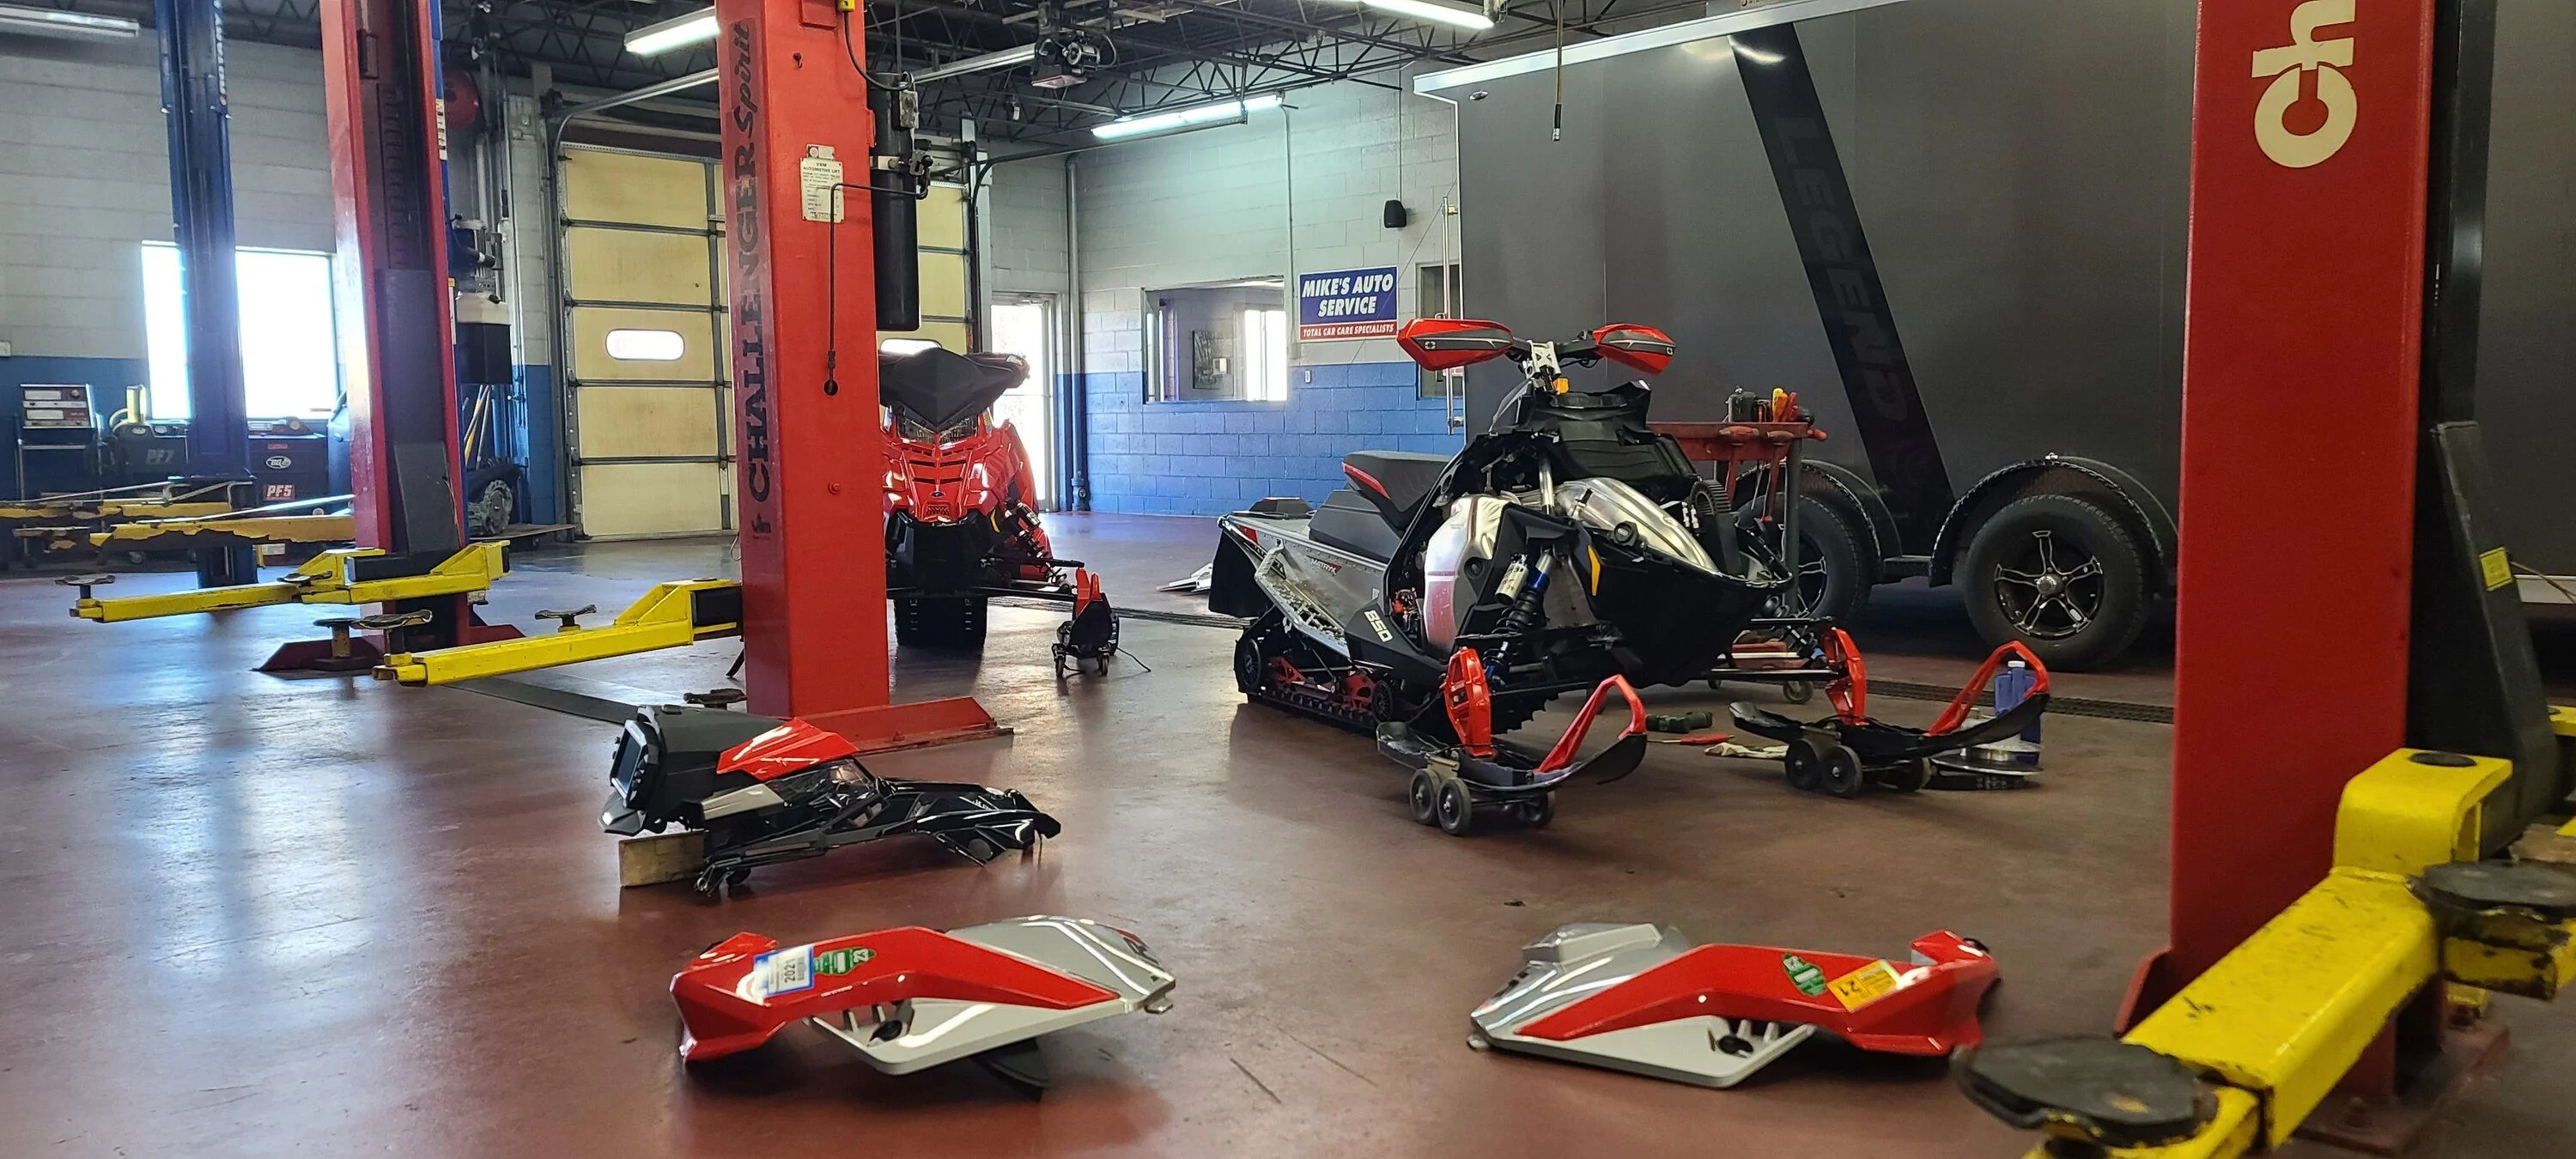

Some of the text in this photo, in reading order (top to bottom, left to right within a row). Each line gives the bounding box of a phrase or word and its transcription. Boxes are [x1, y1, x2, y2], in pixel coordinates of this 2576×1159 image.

[733, 23, 758, 139] Spirit
[1774, 117, 1908, 422] LEGEND
[1302, 274, 1394, 298] MIKE'S AUTO
[1318, 296, 1377, 317] SERVICE
[735, 143, 771, 503] CHALLENGER
[1303, 324, 1394, 337] TOTAL CAR CARE SPECIALISTS
[1364, 610, 1393, 642] 850
[784, 957, 796, 984] 2021
